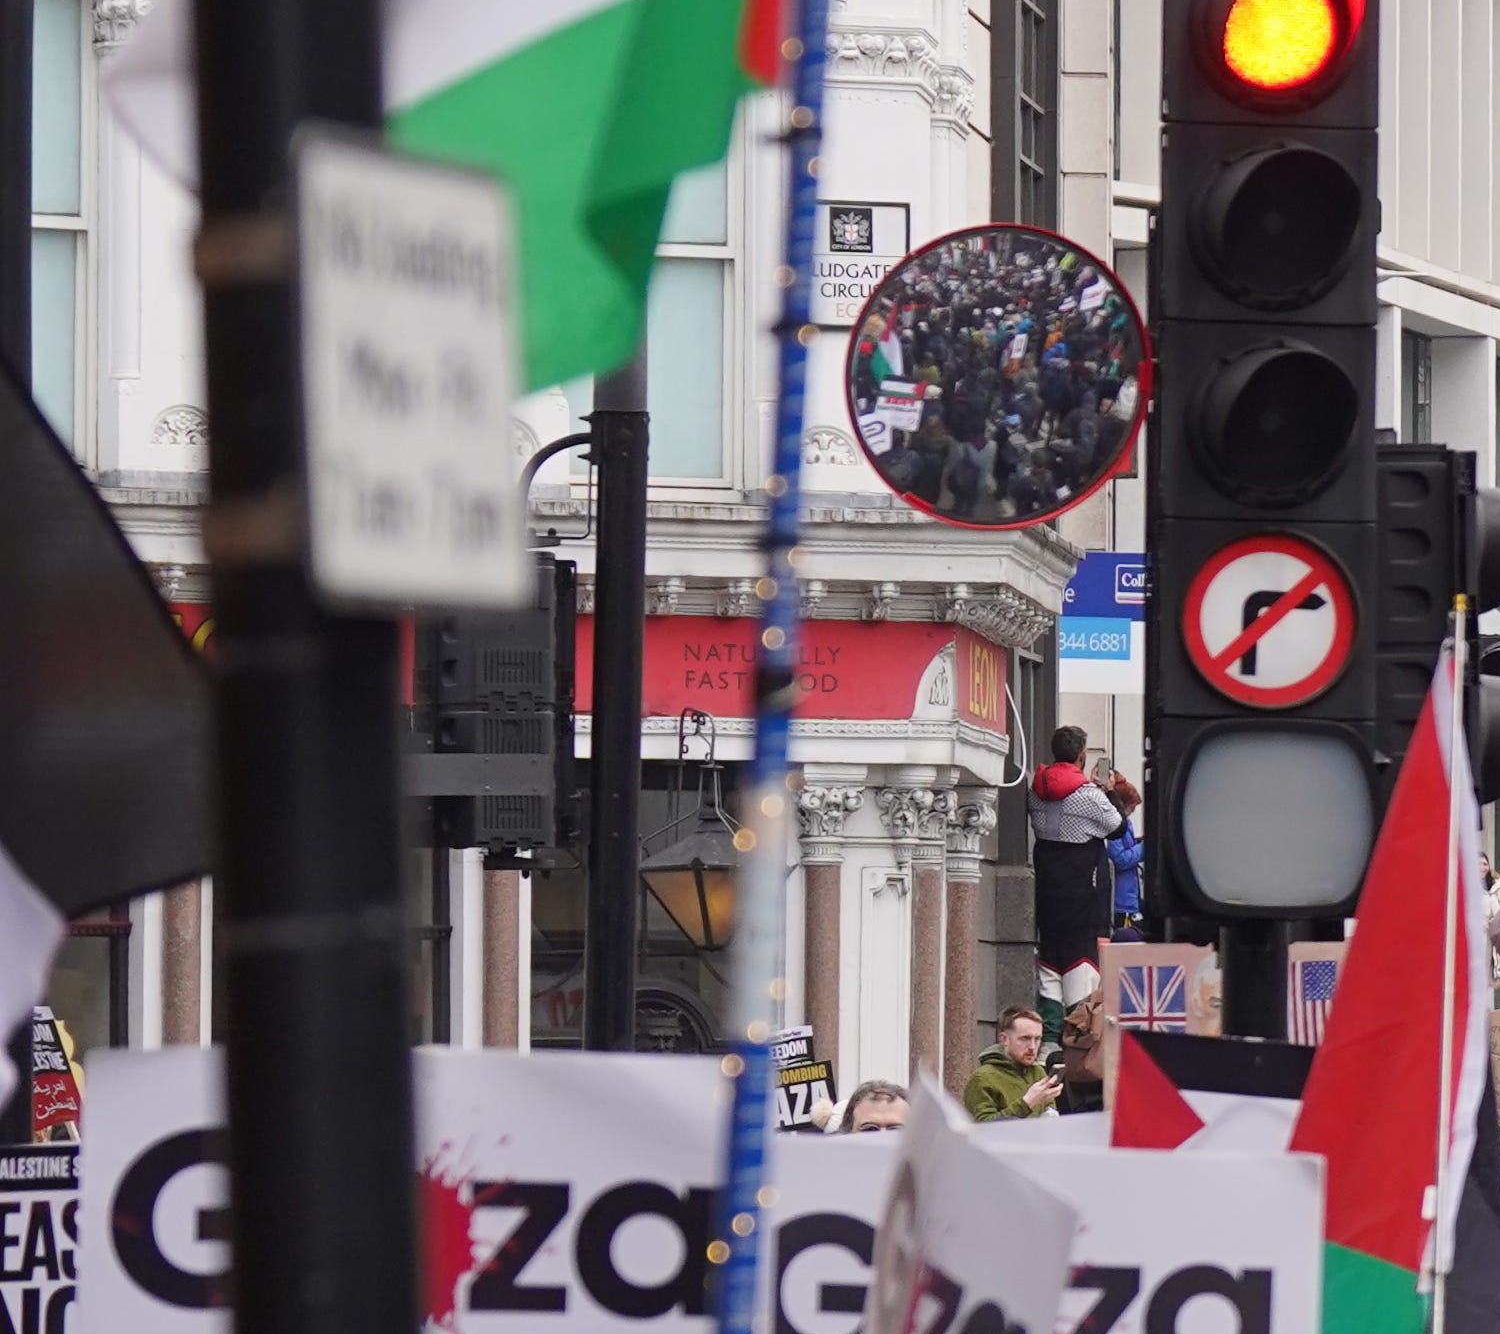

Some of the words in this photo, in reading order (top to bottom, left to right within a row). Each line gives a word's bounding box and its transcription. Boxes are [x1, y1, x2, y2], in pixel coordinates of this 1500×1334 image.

[1090, 632, 1128, 652] 6881
[684, 644, 840, 663] NATULLY
[685, 671, 748, 691] FAST
[969, 643, 997, 722] LEON
[109, 1126, 722, 1317] Gza
